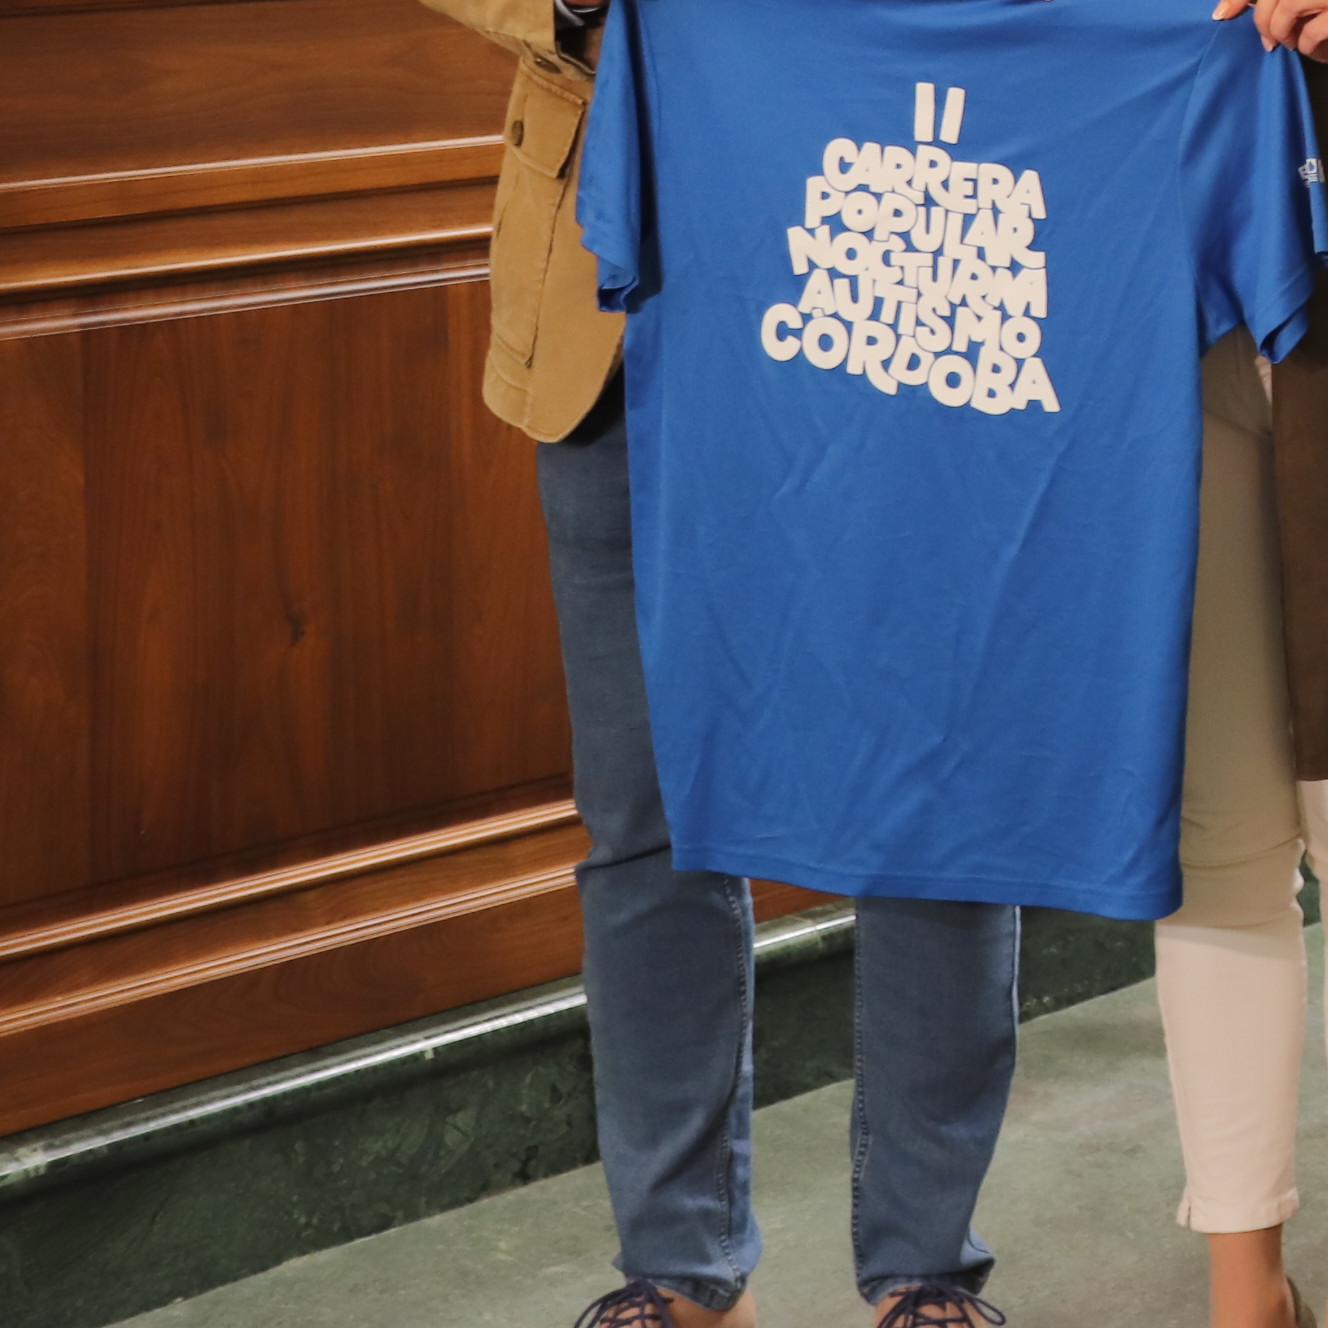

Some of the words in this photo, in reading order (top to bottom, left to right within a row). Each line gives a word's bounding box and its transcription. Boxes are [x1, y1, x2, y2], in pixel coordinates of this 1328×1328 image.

[914, 82, 966, 144] II
[804, 175, 1046, 269] POPULAR
[822, 137, 1047, 219] CARRERA
[786, 225, 1047, 319] NOCTURNA
[797, 268, 1042, 359] AUTISMO
